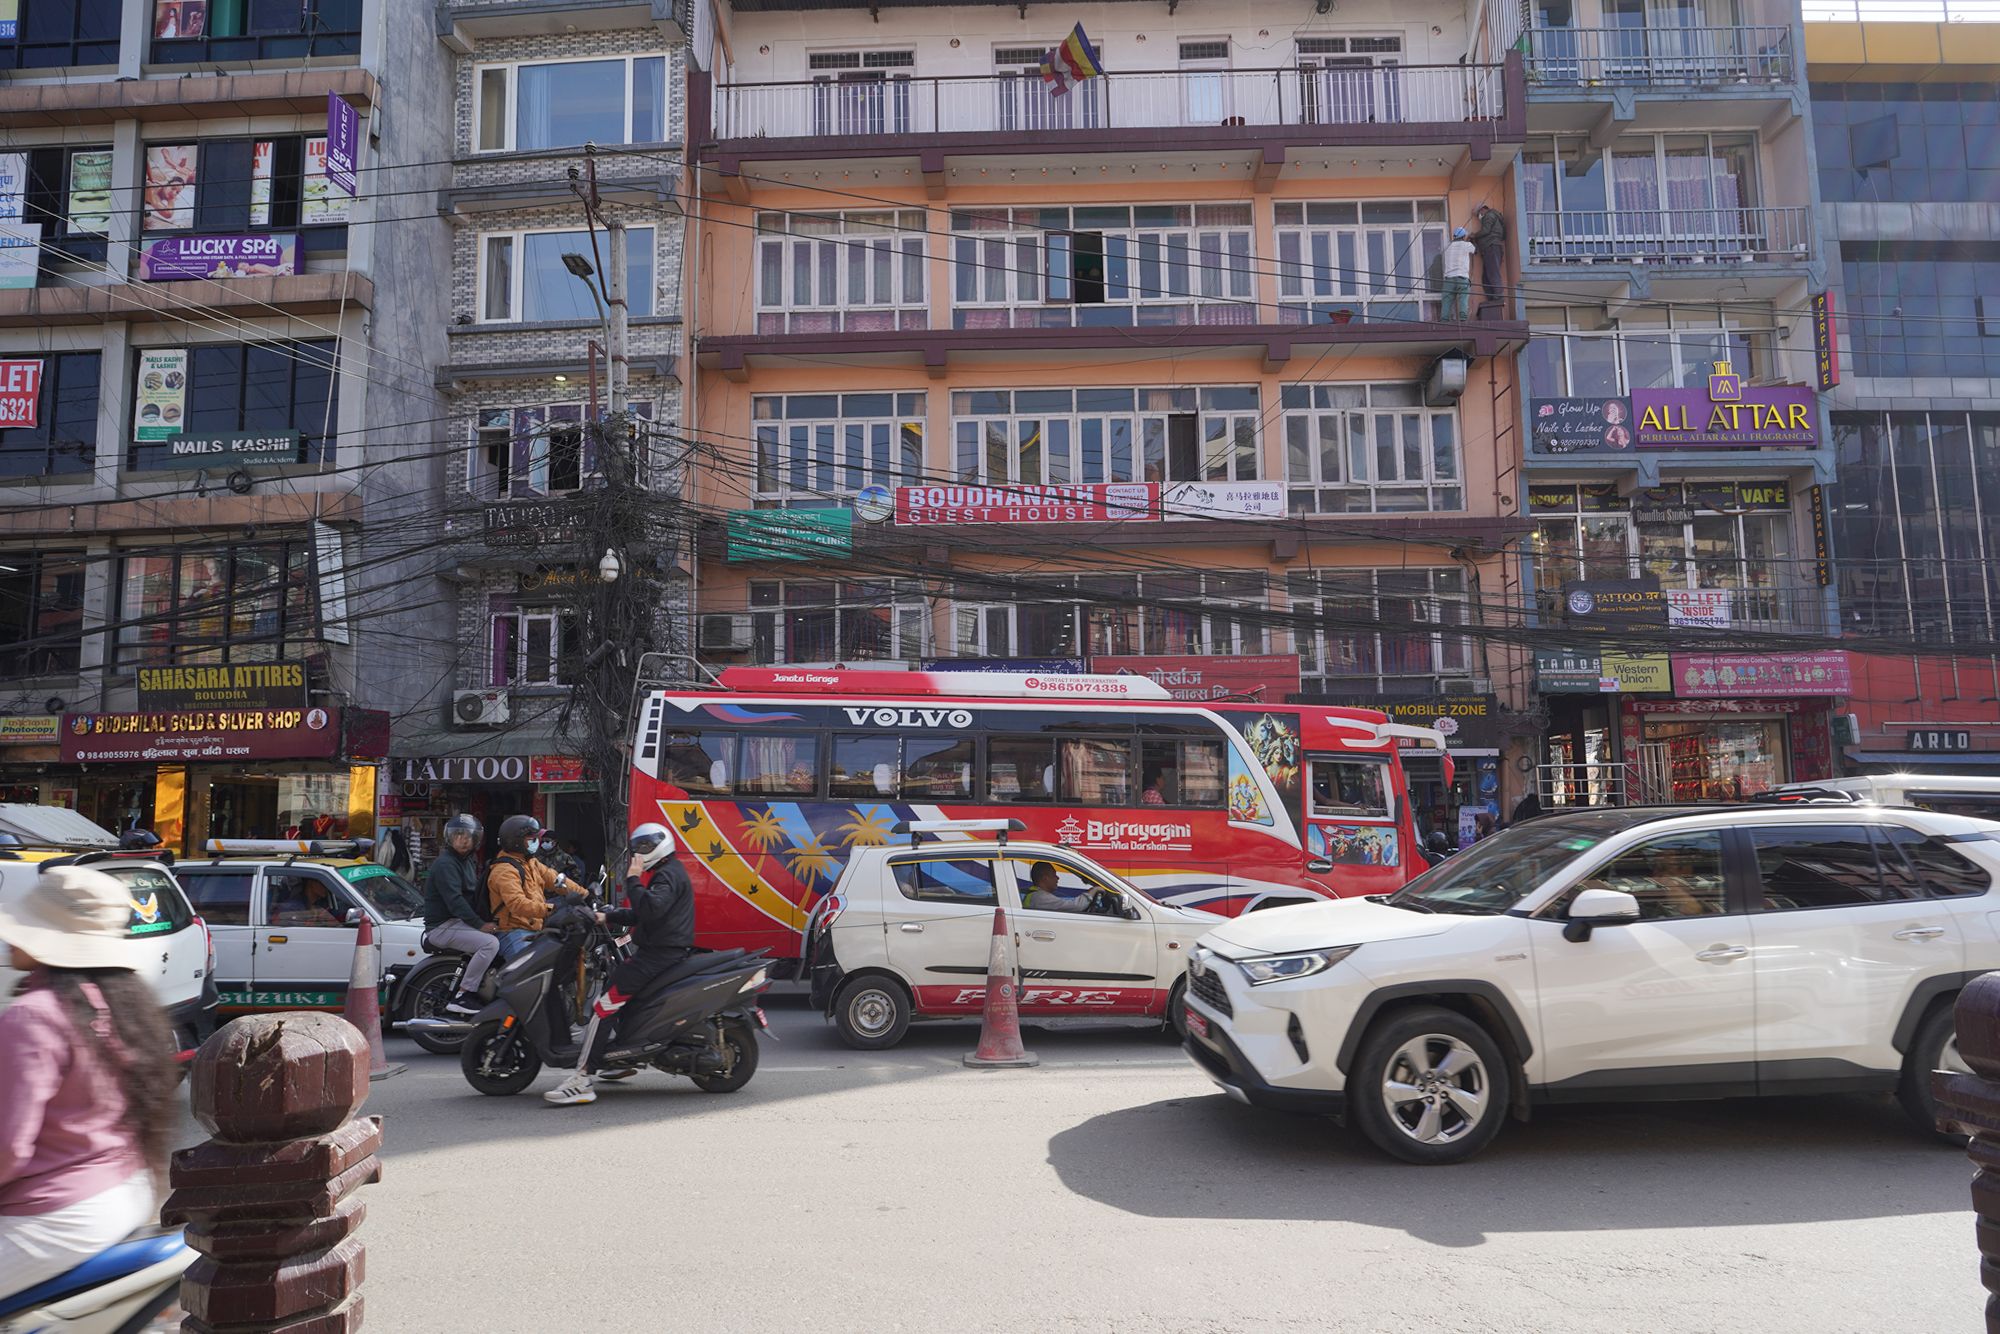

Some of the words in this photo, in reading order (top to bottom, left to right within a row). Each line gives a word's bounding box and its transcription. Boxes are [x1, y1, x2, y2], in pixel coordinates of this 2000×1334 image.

[333, 148, 353, 171] SPA
[179, 239, 238, 255] LUCKY
[241, 238, 278, 254] SPA
[1817, 296, 1830, 385] PERFUME
[1558, 401, 1583, 417] Glow
[1586, 402, 1601, 416] Up
[1639, 404, 1698, 431] ALL
[1707, 403, 1811, 430] ATTAR
[1536, 422, 1559, 433] Nails
[1563, 422, 1572, 433] &
[1575, 422, 1604, 433] Lashes
[172, 440, 224, 454] NAILS
[908, 485, 1094, 508] BOUDHANATH
[1741, 488, 1785, 503] VAPE
[908, 508, 991, 522] GUEST
[1009, 507, 1094, 521] HOUSE
[1667, 508, 1693, 521] Smoke
[1594, 592, 1642, 603] TATTOO
[1671, 592, 1723, 605] TO-LET
[1683, 606, 1715, 616] INSIDE
[1613, 665, 1659, 674] Western
[139, 667, 230, 691] SAHASARA
[234, 664, 303, 689] ATTIRES
[772, 673, 804, 683] Janata
[806, 674, 839, 685] Garage
[1621, 674, 1653, 684] Union
[1039, 682, 1128, 693] 9865074338
[194, 690, 248, 701] BOUDDHA
[1395, 704, 1447, 716] MOBILE
[1450, 704, 1487, 716] ZONE
[95, 714, 166, 734] BUDDHILAL
[170, 713, 203, 732] GOLD
[206, 712, 216, 731] &
[219, 711, 263, 731] SILVER
[268, 710, 302, 729] SHOP
[842, 707, 973, 728] VOLVO
[2, 726, 55, 734] Photocopy
[1912, 732, 1968, 749] ARLO
[400, 756, 524, 780] TATTOO
[1087, 818, 1191, 842] Bajrayogini
[1130, 841, 1167, 851] Darshan
